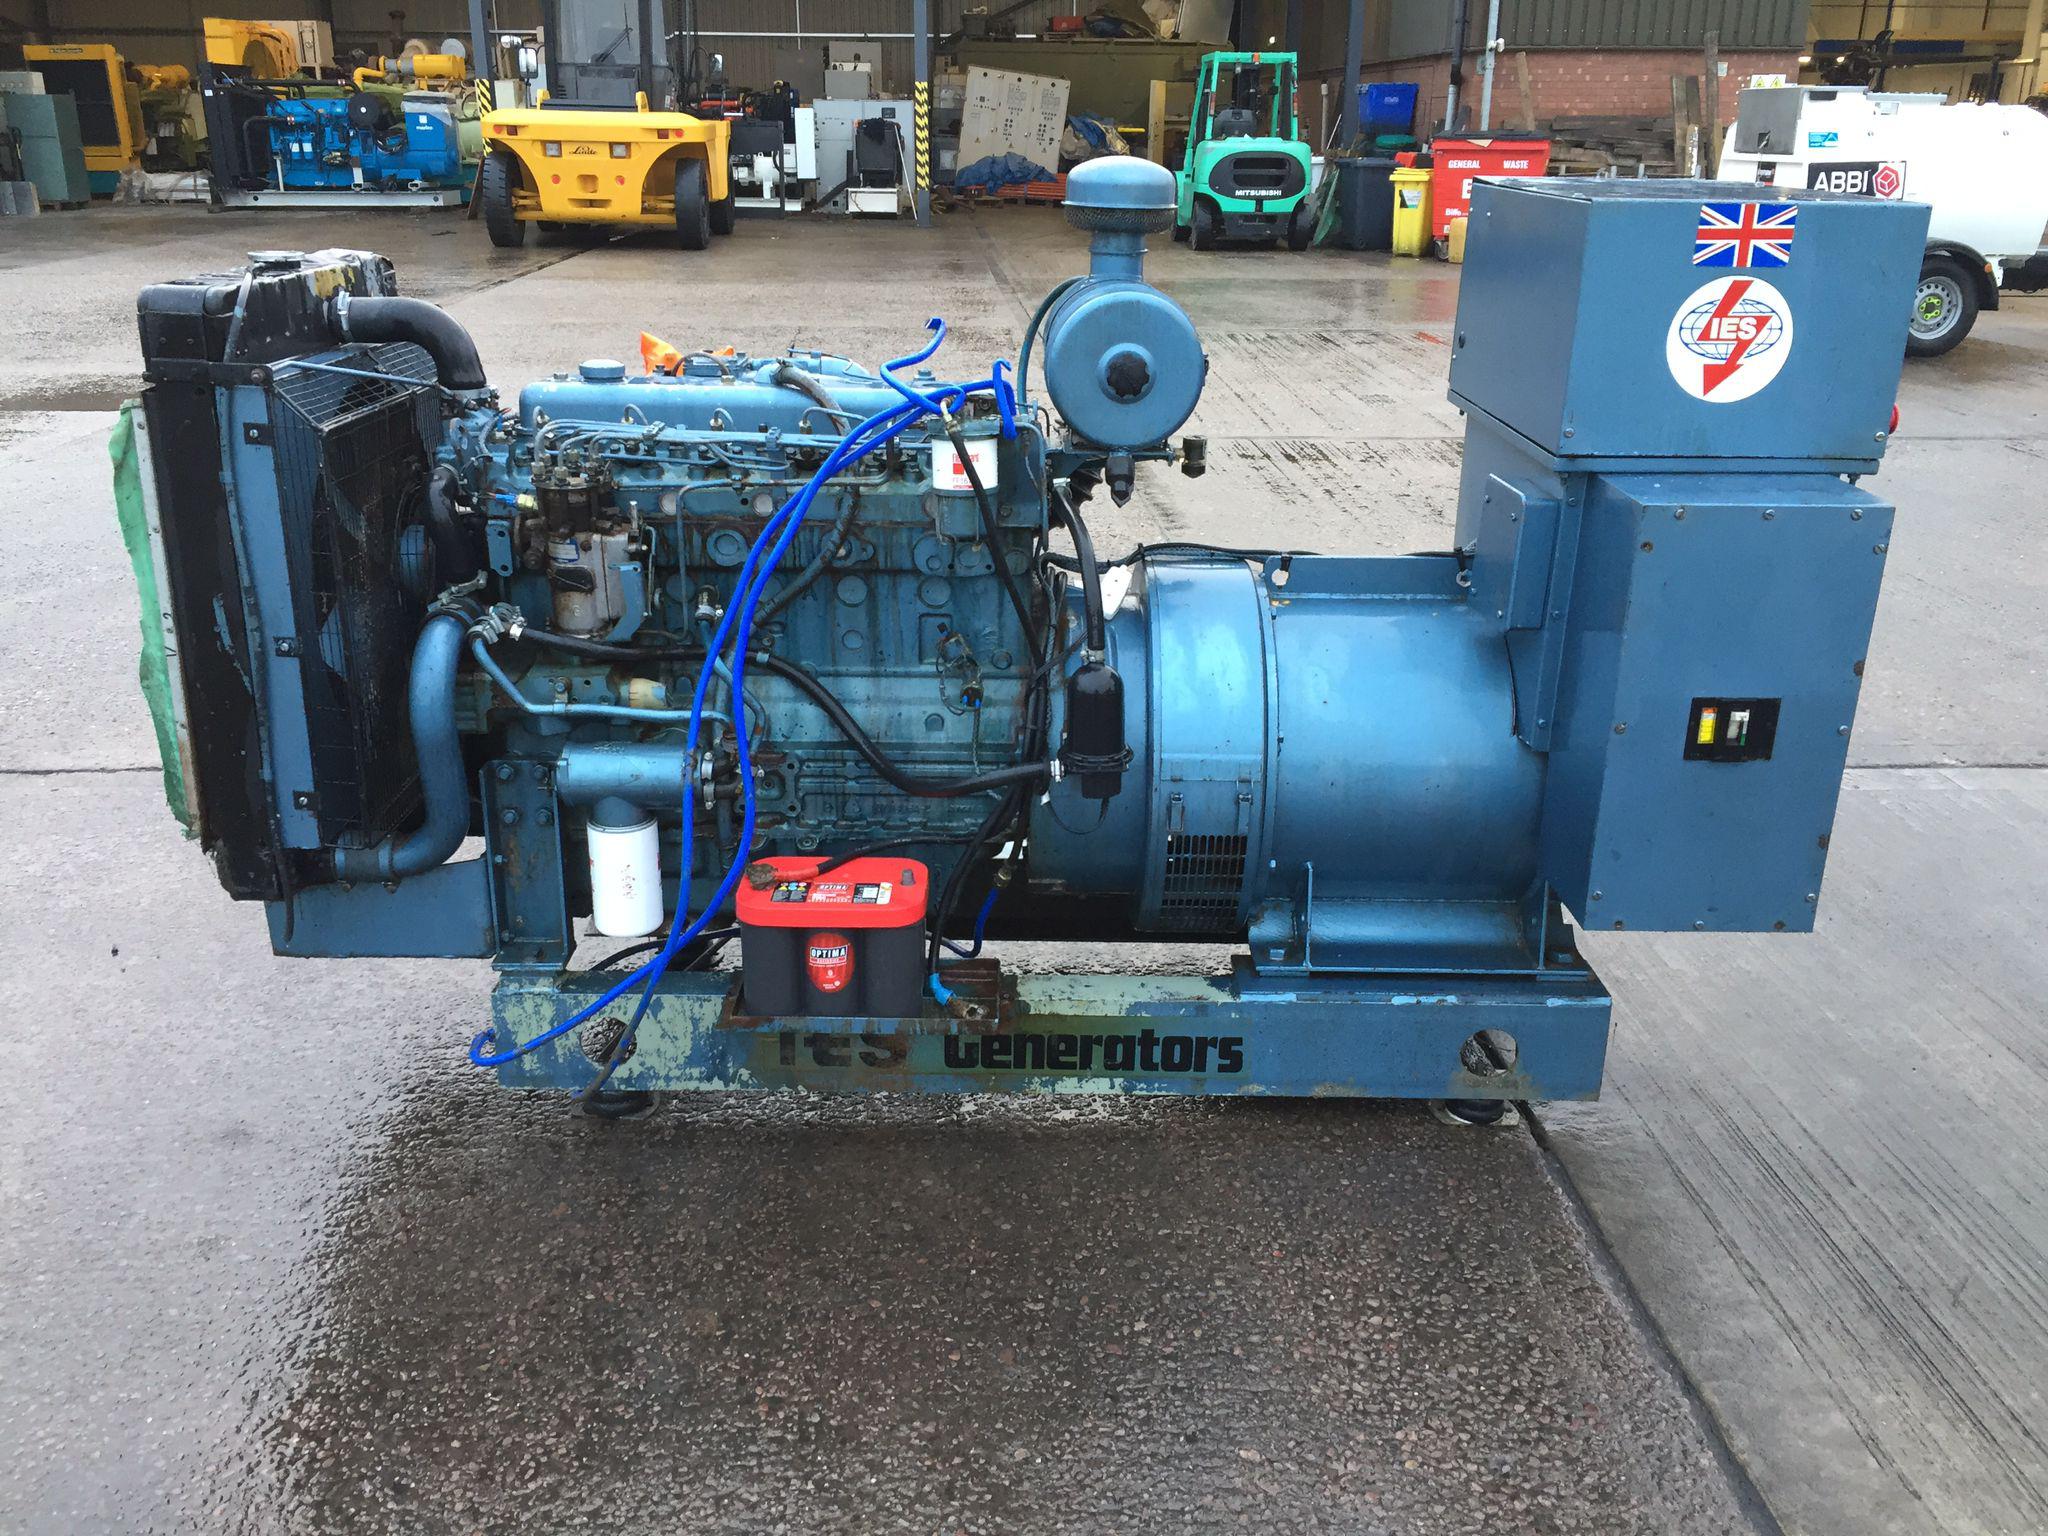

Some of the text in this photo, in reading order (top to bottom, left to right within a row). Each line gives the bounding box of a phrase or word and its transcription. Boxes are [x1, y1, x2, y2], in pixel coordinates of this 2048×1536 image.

[569, 144, 597, 154] Linde
[1448, 160, 1529, 168] GENERAL WASTE
[1813, 169, 1871, 192] ABBI
[1709, 316, 1758, 340] IES
[811, 947, 846, 958] OPTIMA
[944, 1029, 1243, 1072] Generators
